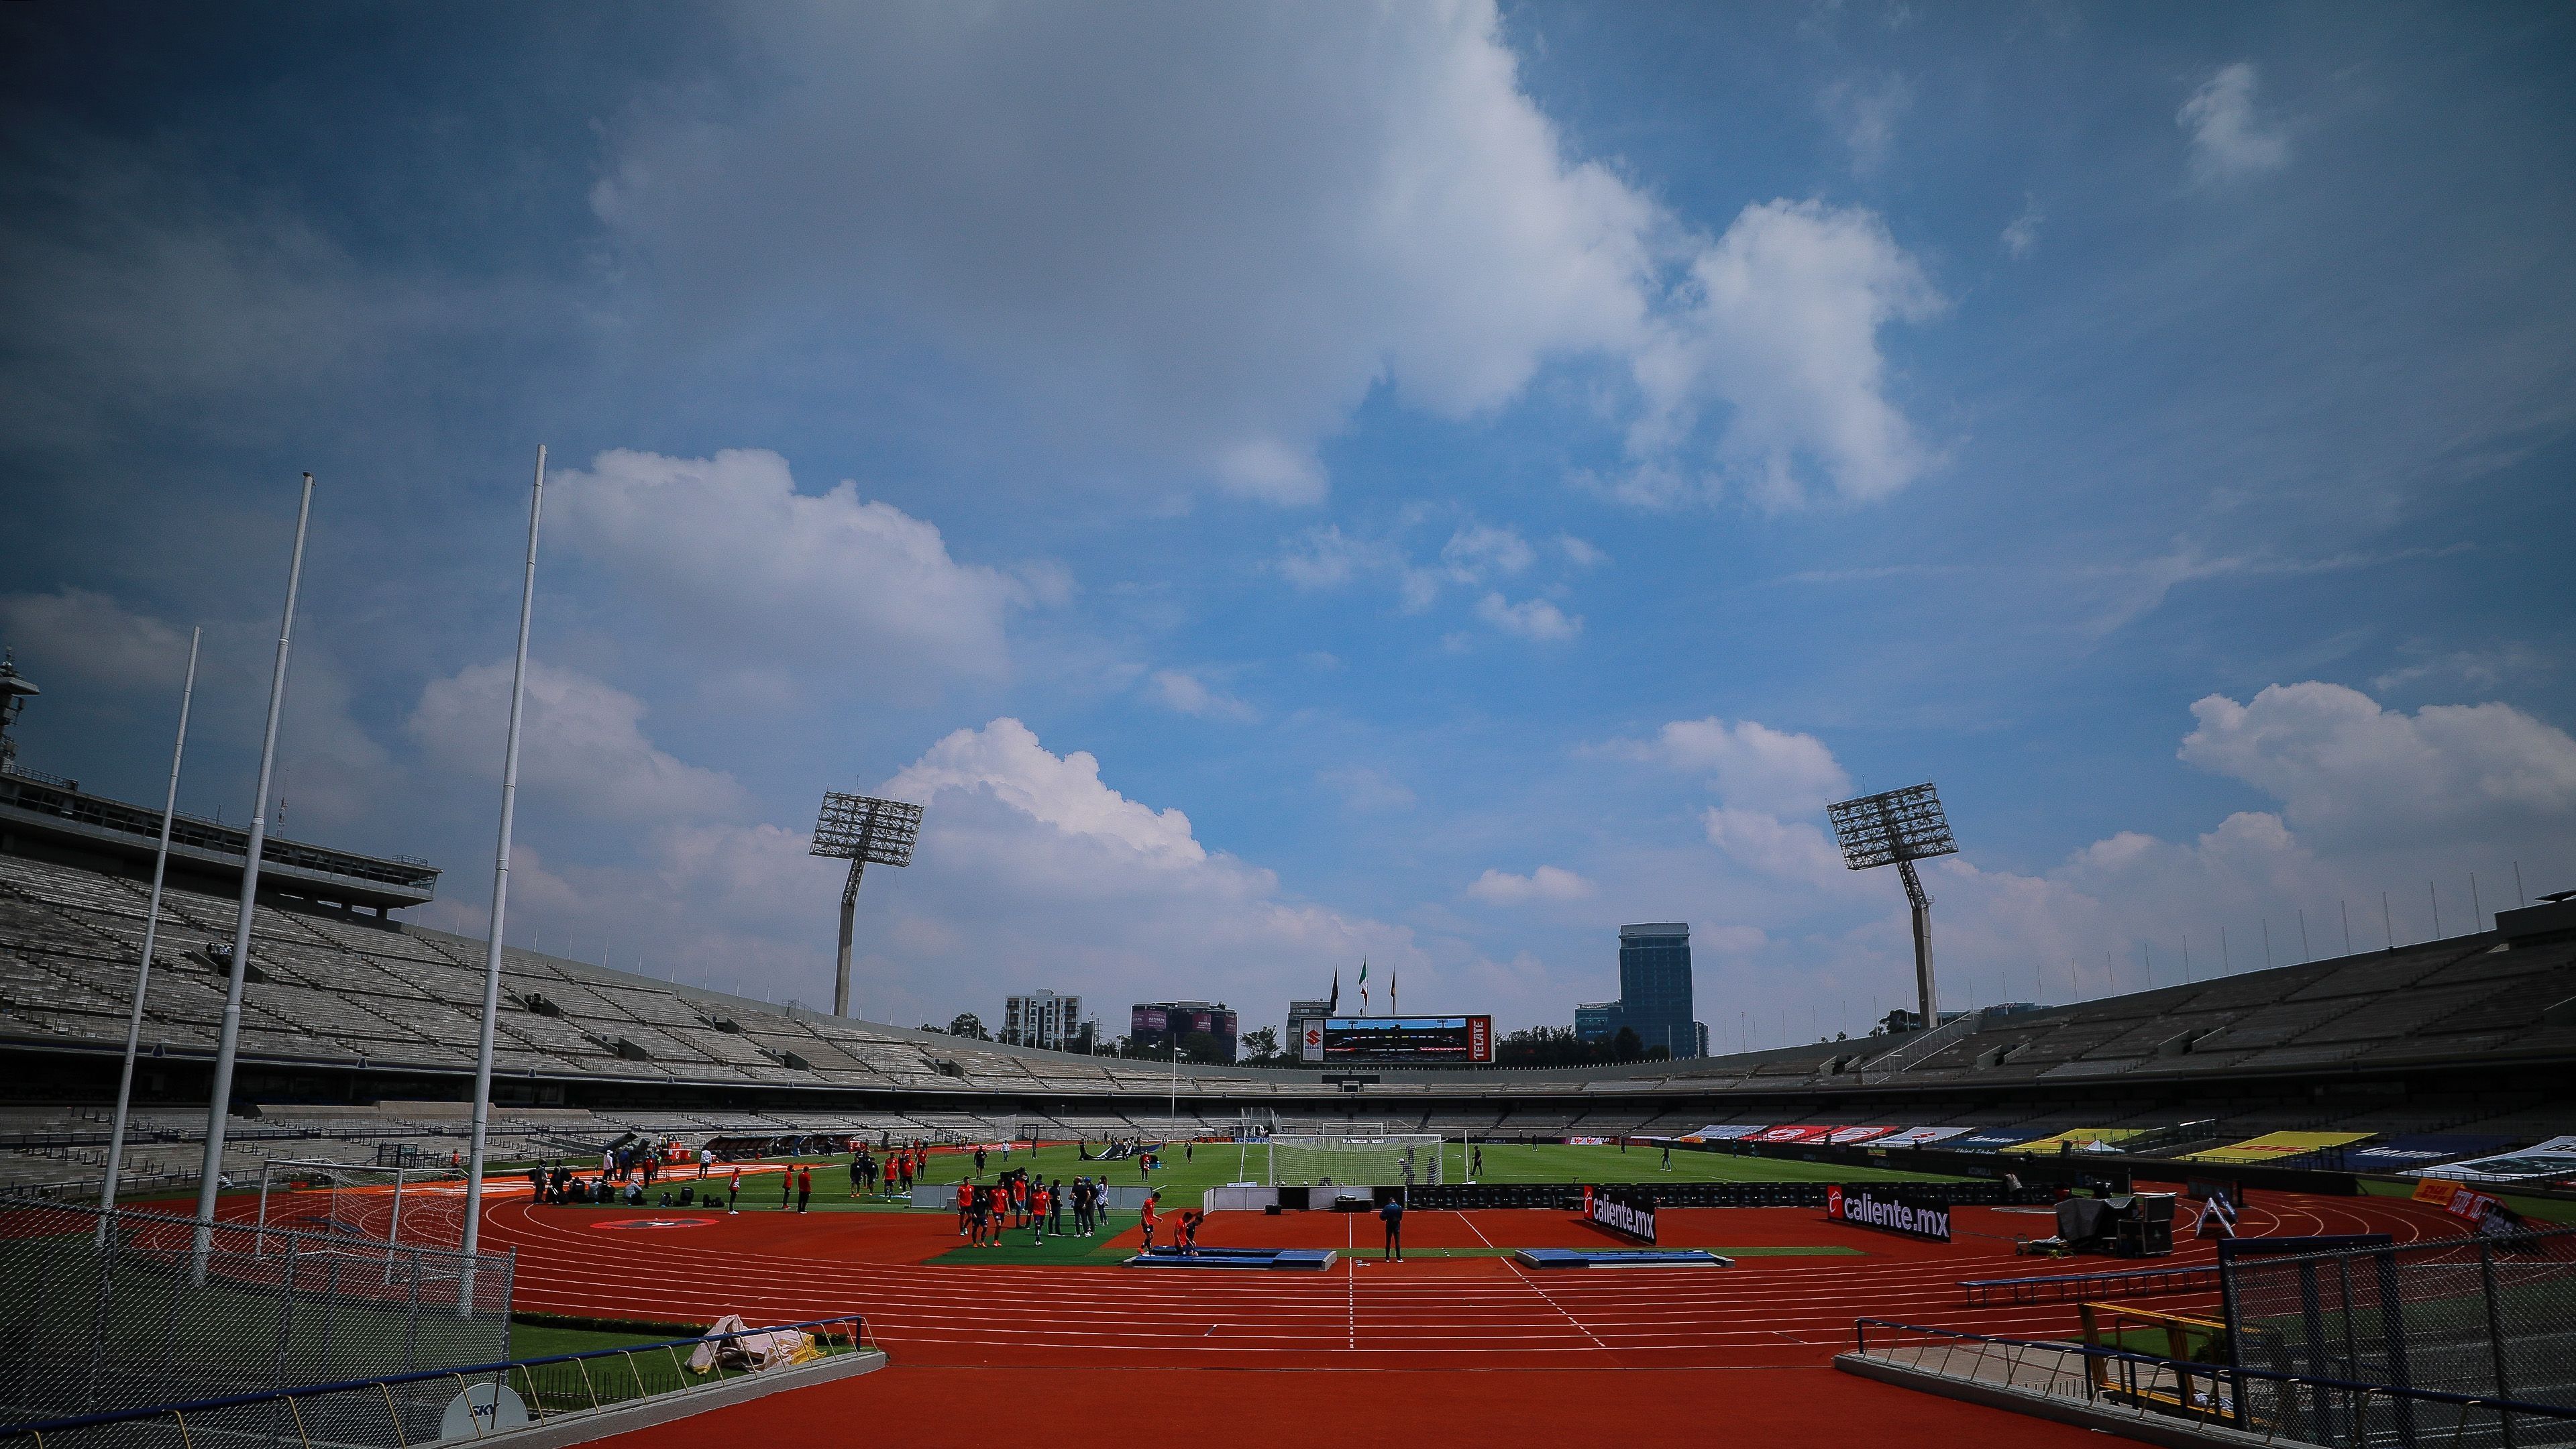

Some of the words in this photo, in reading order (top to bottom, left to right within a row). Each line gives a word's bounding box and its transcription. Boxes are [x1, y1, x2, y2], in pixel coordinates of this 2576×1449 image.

[1474, 1020, 1485, 1060] TECATE
[1593, 1193, 1654, 1240] caliente.mx
[1844, 1193, 1949, 1238] caliente.mx
